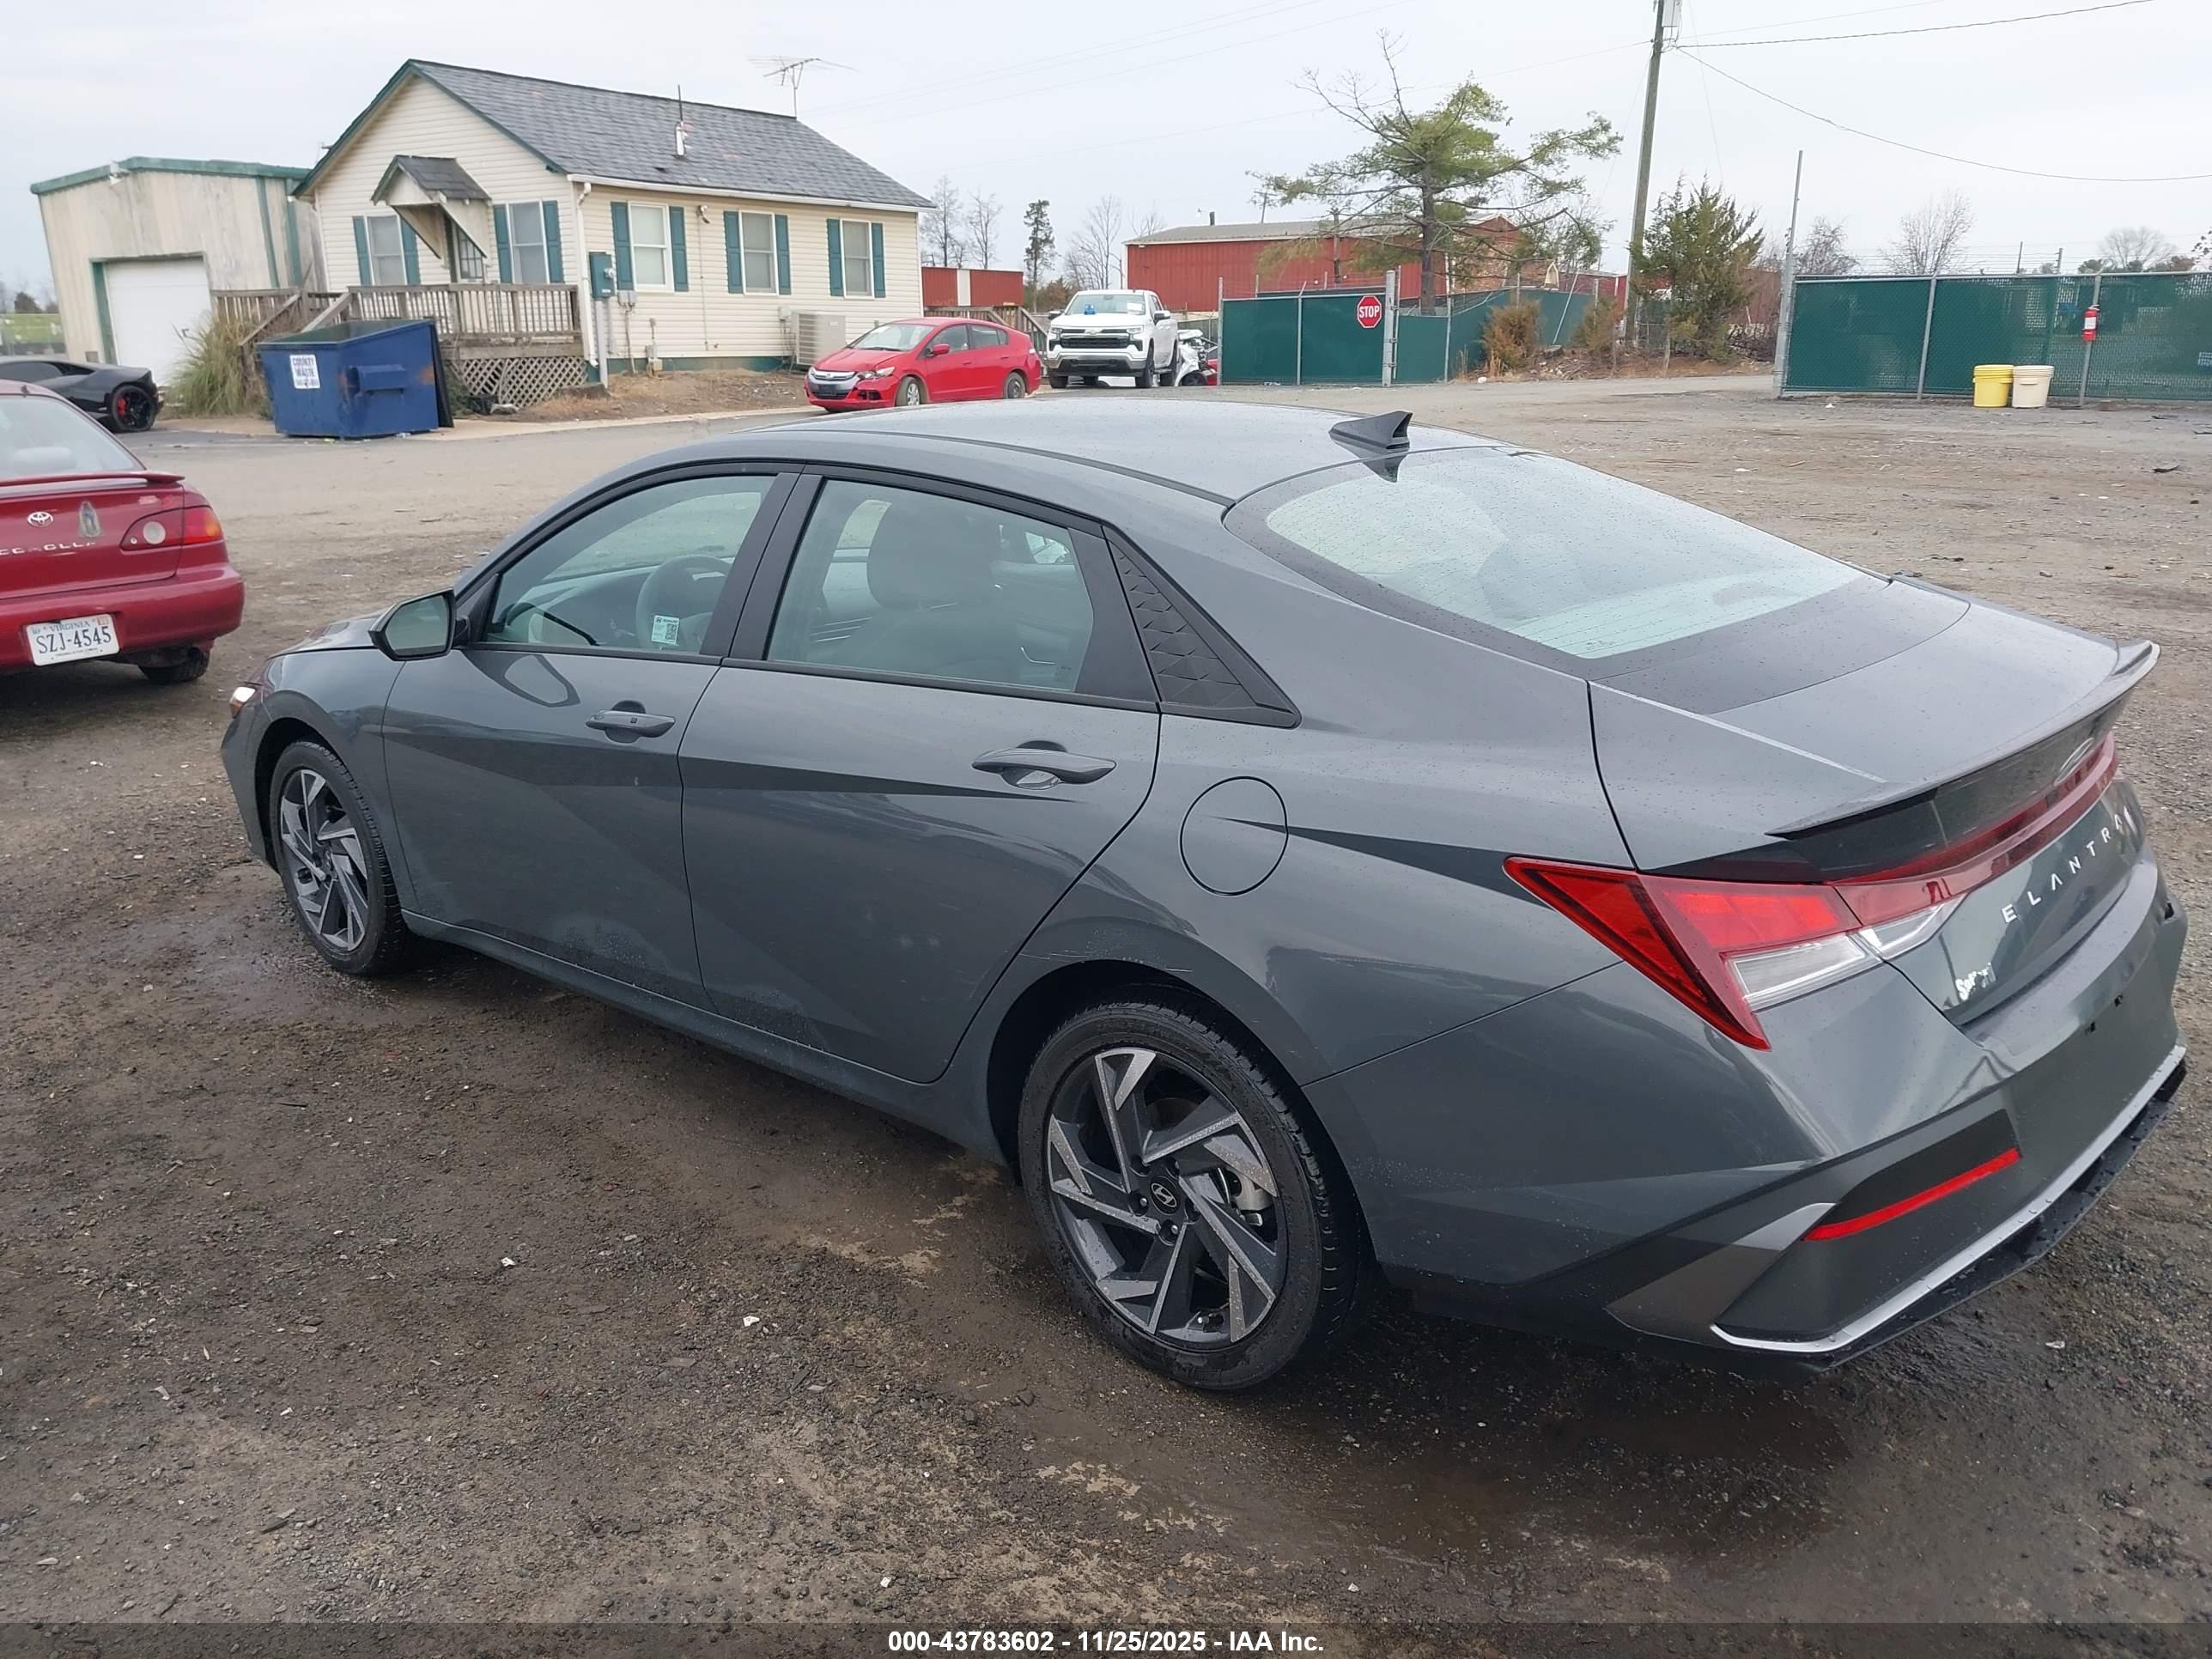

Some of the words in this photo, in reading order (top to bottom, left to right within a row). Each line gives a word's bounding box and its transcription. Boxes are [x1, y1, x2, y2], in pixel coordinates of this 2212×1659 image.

[1359, 305, 1380, 318] STOP
[49, 621, 90, 632] VIRGINIA
[36, 626, 112, 653] SZJ-4545
[2001, 814, 2124, 923] ELANTRA
